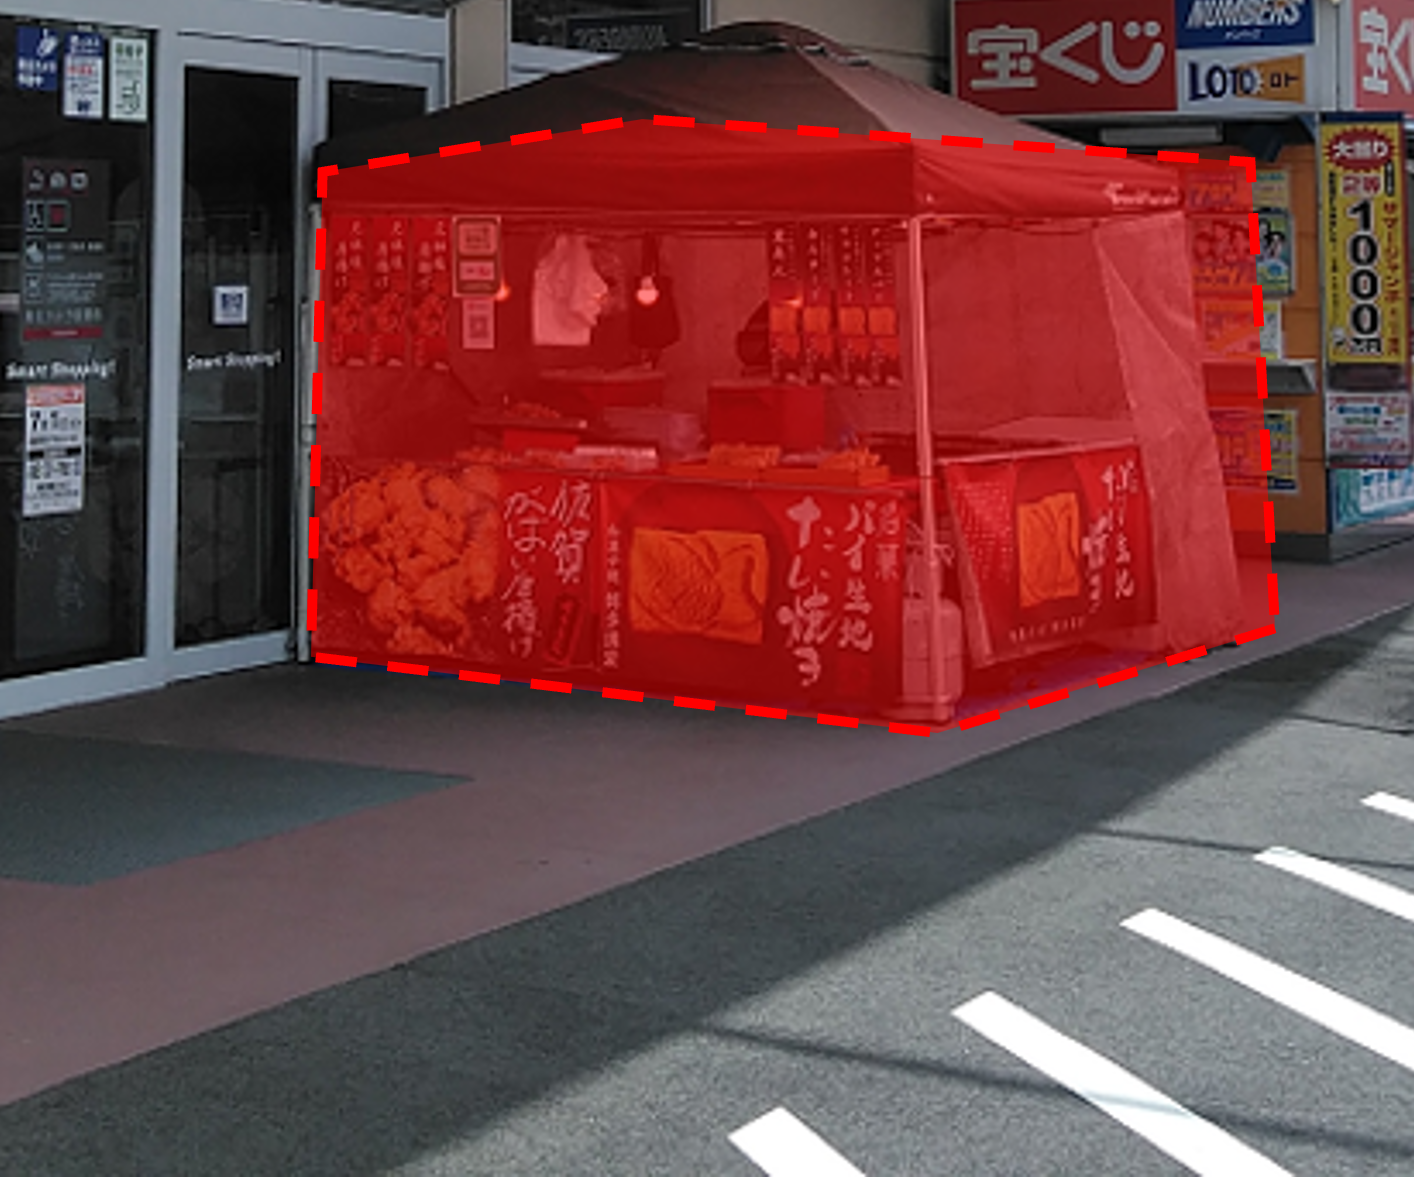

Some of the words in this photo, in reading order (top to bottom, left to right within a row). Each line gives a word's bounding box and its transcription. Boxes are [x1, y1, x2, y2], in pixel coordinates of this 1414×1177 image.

[967, 21, 1165, 90] 宝くじ
[1188, 62, 1256, 101] LOTO
